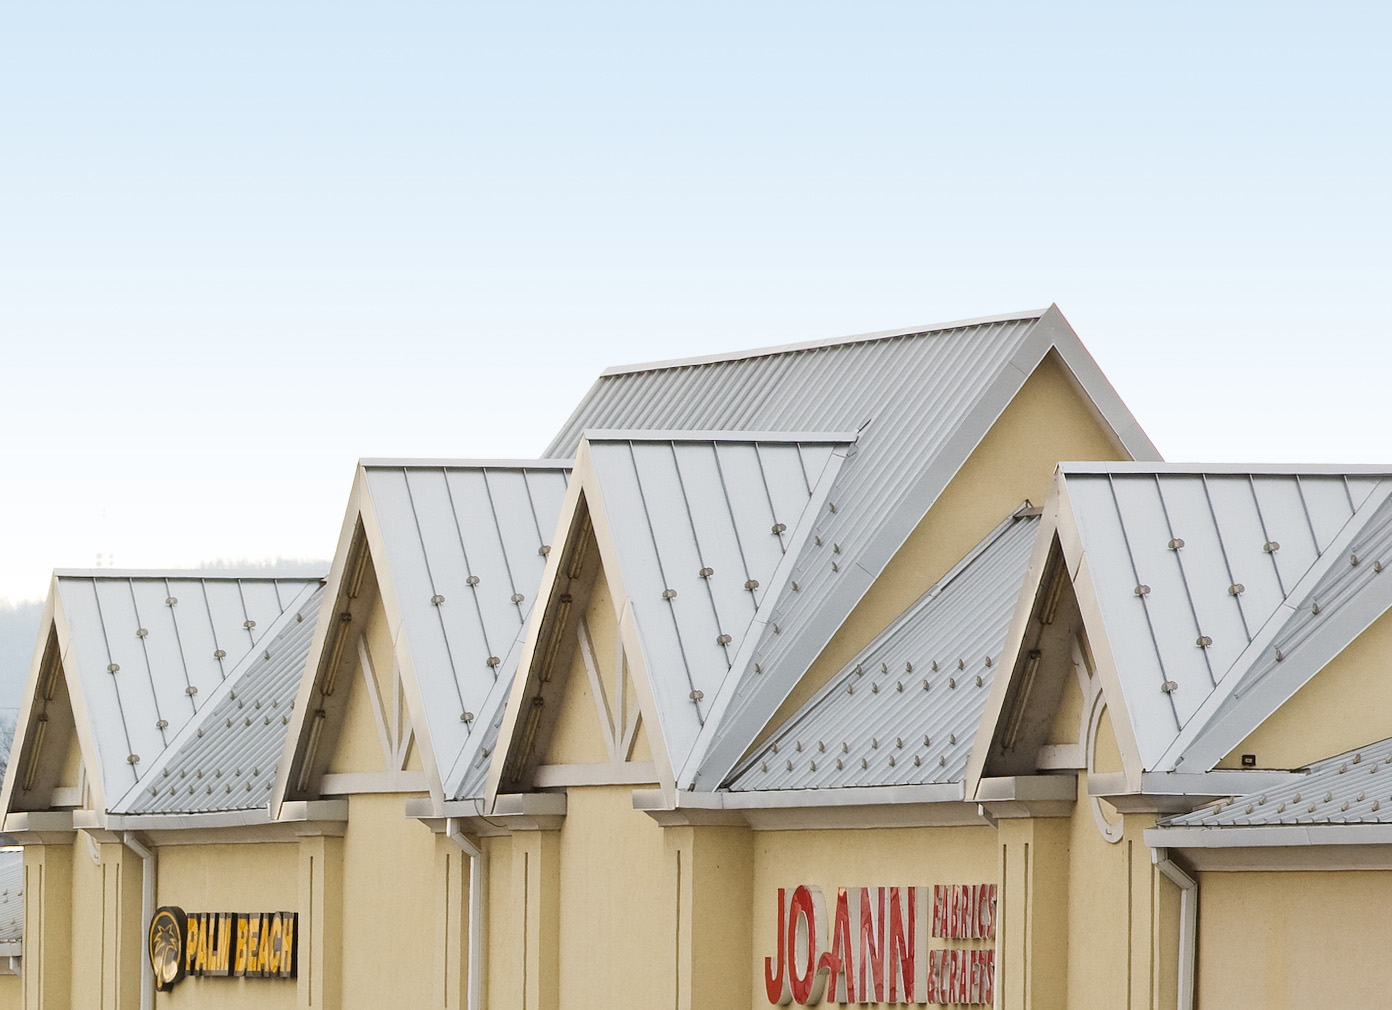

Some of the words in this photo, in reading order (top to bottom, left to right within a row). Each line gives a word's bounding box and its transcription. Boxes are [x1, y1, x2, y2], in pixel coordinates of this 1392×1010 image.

[932, 884, 997, 939] FABRICS
[185, 913, 232, 976] PALM
[234, 912, 295, 977] BEACH
